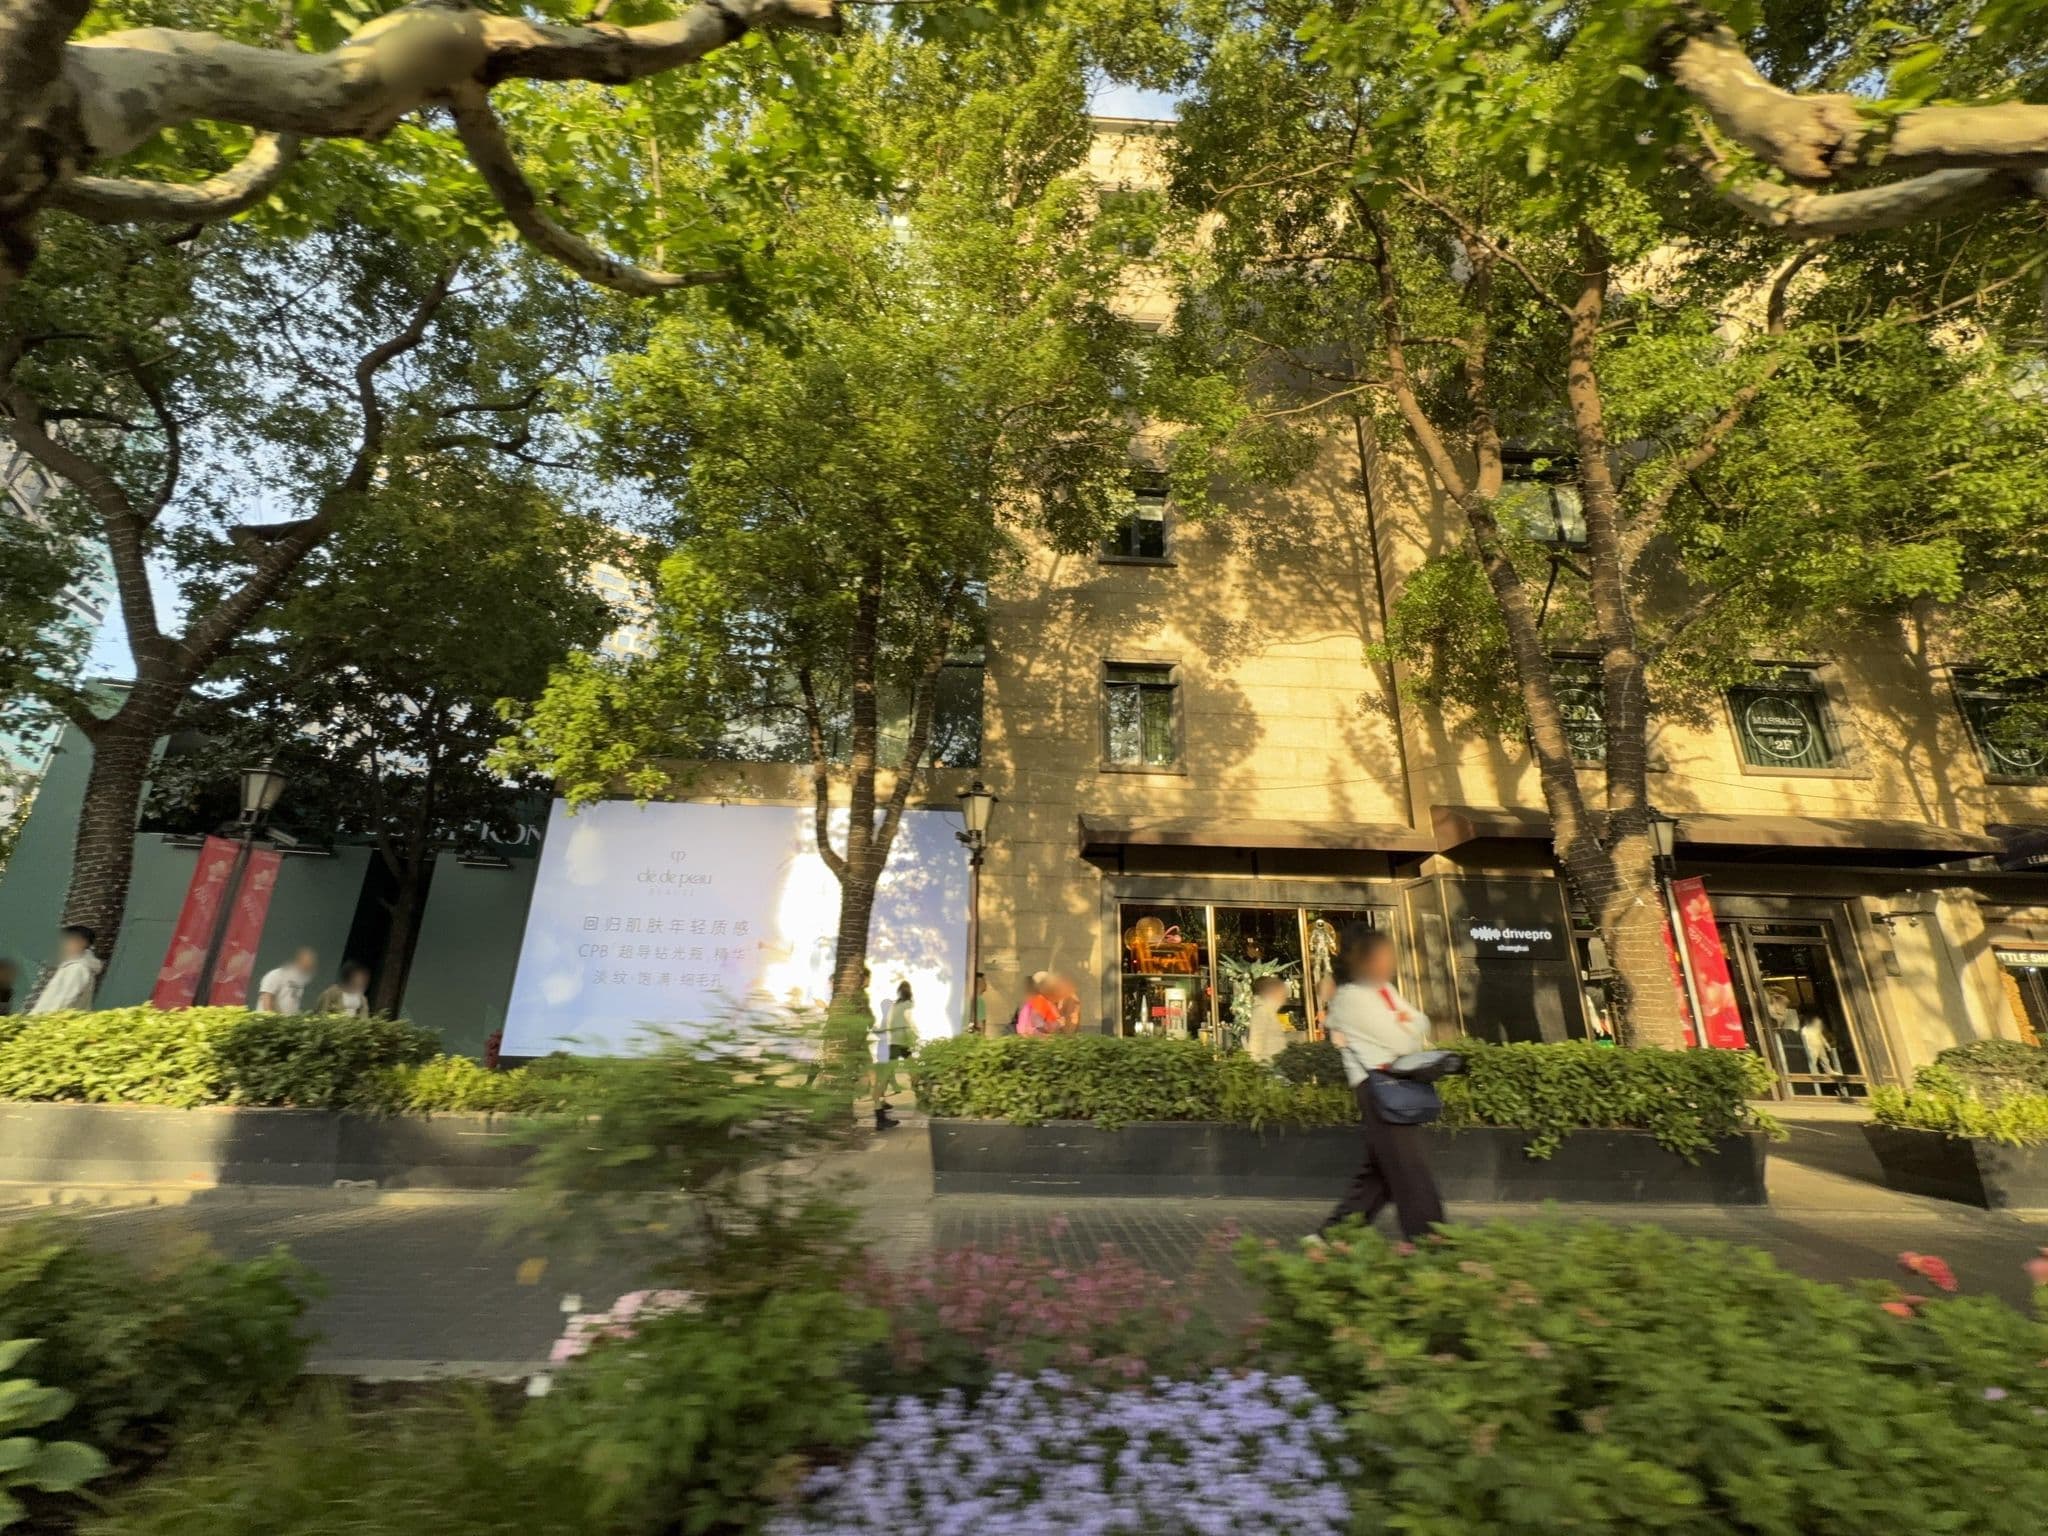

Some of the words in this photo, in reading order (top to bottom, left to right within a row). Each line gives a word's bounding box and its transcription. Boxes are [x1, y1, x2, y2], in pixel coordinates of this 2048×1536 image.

[1558, 704, 1602, 721] SPA
[1774, 739, 1793, 751] 2F
[678, 874, 712, 887] peau
[583, 916, 751, 936] 回归肌肤年轻质感
[1502, 928, 1552, 941] drivepro
[578, 943, 609, 959] CPB
